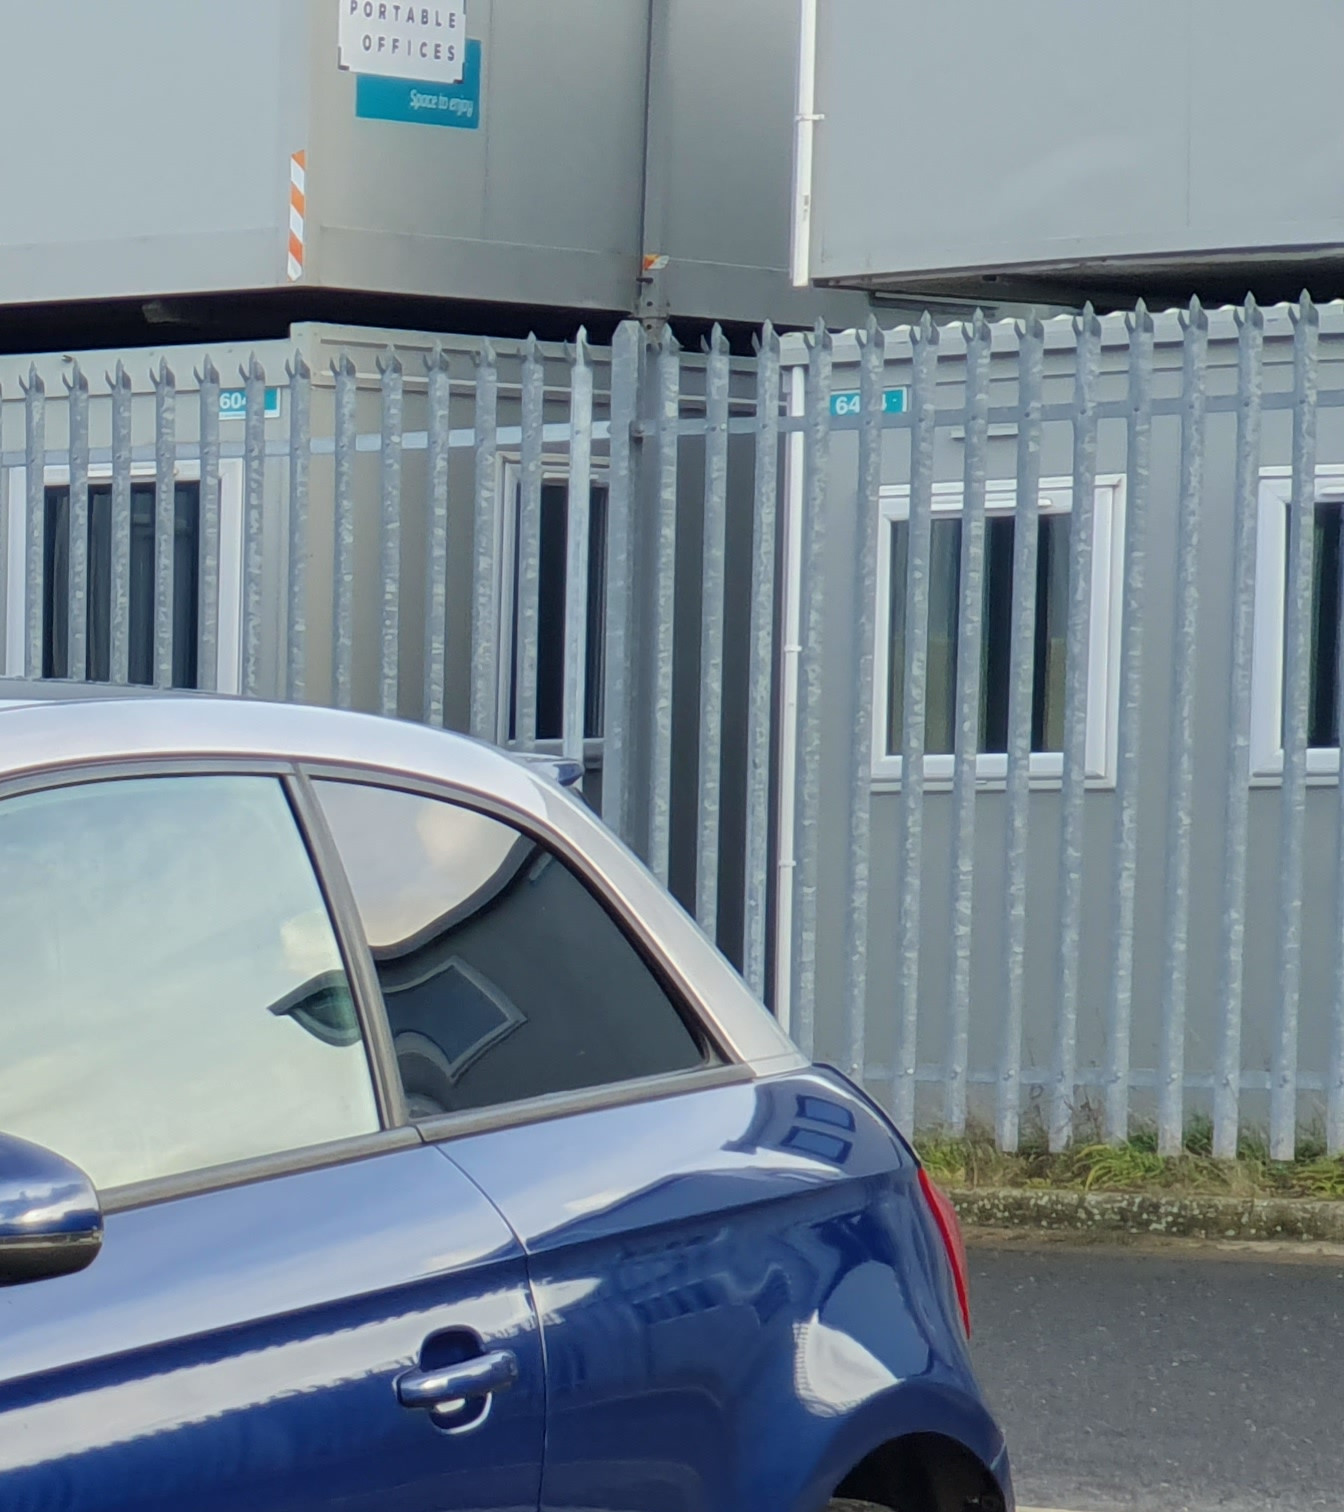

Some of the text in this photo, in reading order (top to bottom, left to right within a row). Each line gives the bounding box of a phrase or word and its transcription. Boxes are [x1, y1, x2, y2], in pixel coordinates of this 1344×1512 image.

[350, 0, 456, 29] PORTABLE
[362, 34, 455, 61] OFFICES
[410, 89, 437, 110] Space
[449, 95, 474, 117] enjoy
